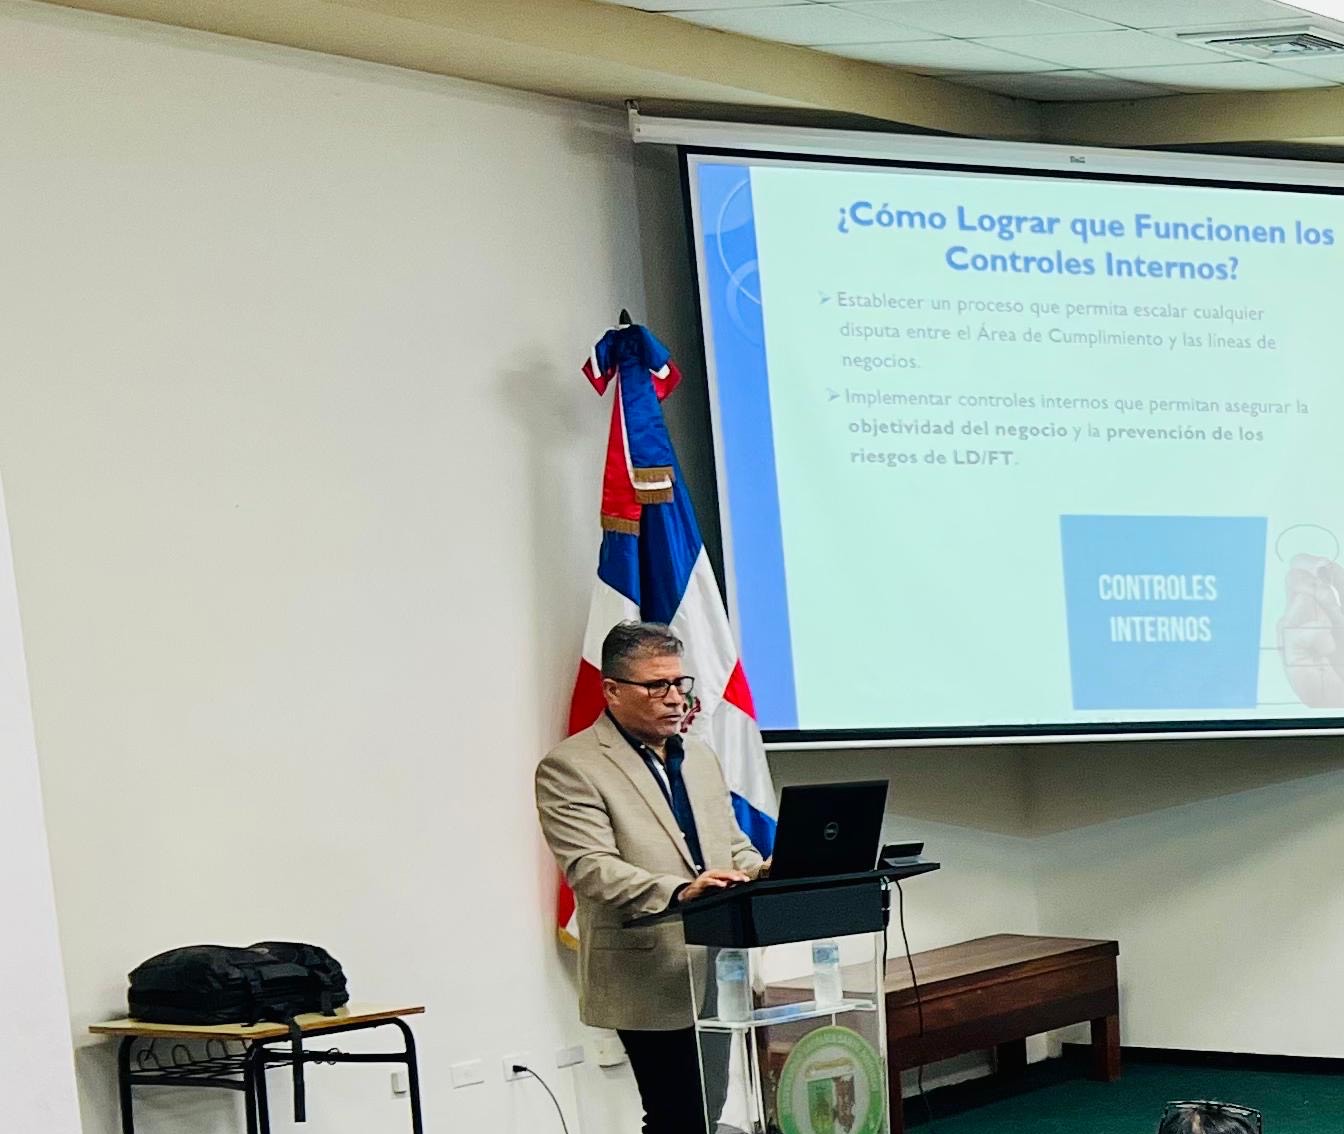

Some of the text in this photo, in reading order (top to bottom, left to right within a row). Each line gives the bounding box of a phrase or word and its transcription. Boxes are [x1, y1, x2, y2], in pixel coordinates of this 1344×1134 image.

[837, 201, 1335, 245] ¿Cómo Lograr que Funcionen los
[945, 246, 1239, 280] Controles Internos?
[837, 291, 1264, 324] Establecer un proceso que permita escalar cualquier
[840, 321, 900, 341] disputa
[906, 325, 951, 340] entre
[957, 325, 971, 341] el
[977, 322, 1017, 342] Área
[1023, 327, 1042, 343] de
[1048, 327, 1163, 348] Cumplimiento
[1169, 335, 1178, 350] y
[1182, 332, 1202, 348] las
[1257, 335, 1277, 350] de
[842, 353, 921, 371] negocios.
[845, 388, 1309, 417] Implementar controles internos que permitan asegurar la
[848, 418, 1264, 442] objetividad del negocio y la prevención de los
[850, 448, 1020, 467] riesgos de LD/FT.
[1099, 574, 1217, 601] CONTROLES
[1110, 616, 1212, 643] INTERNOS
